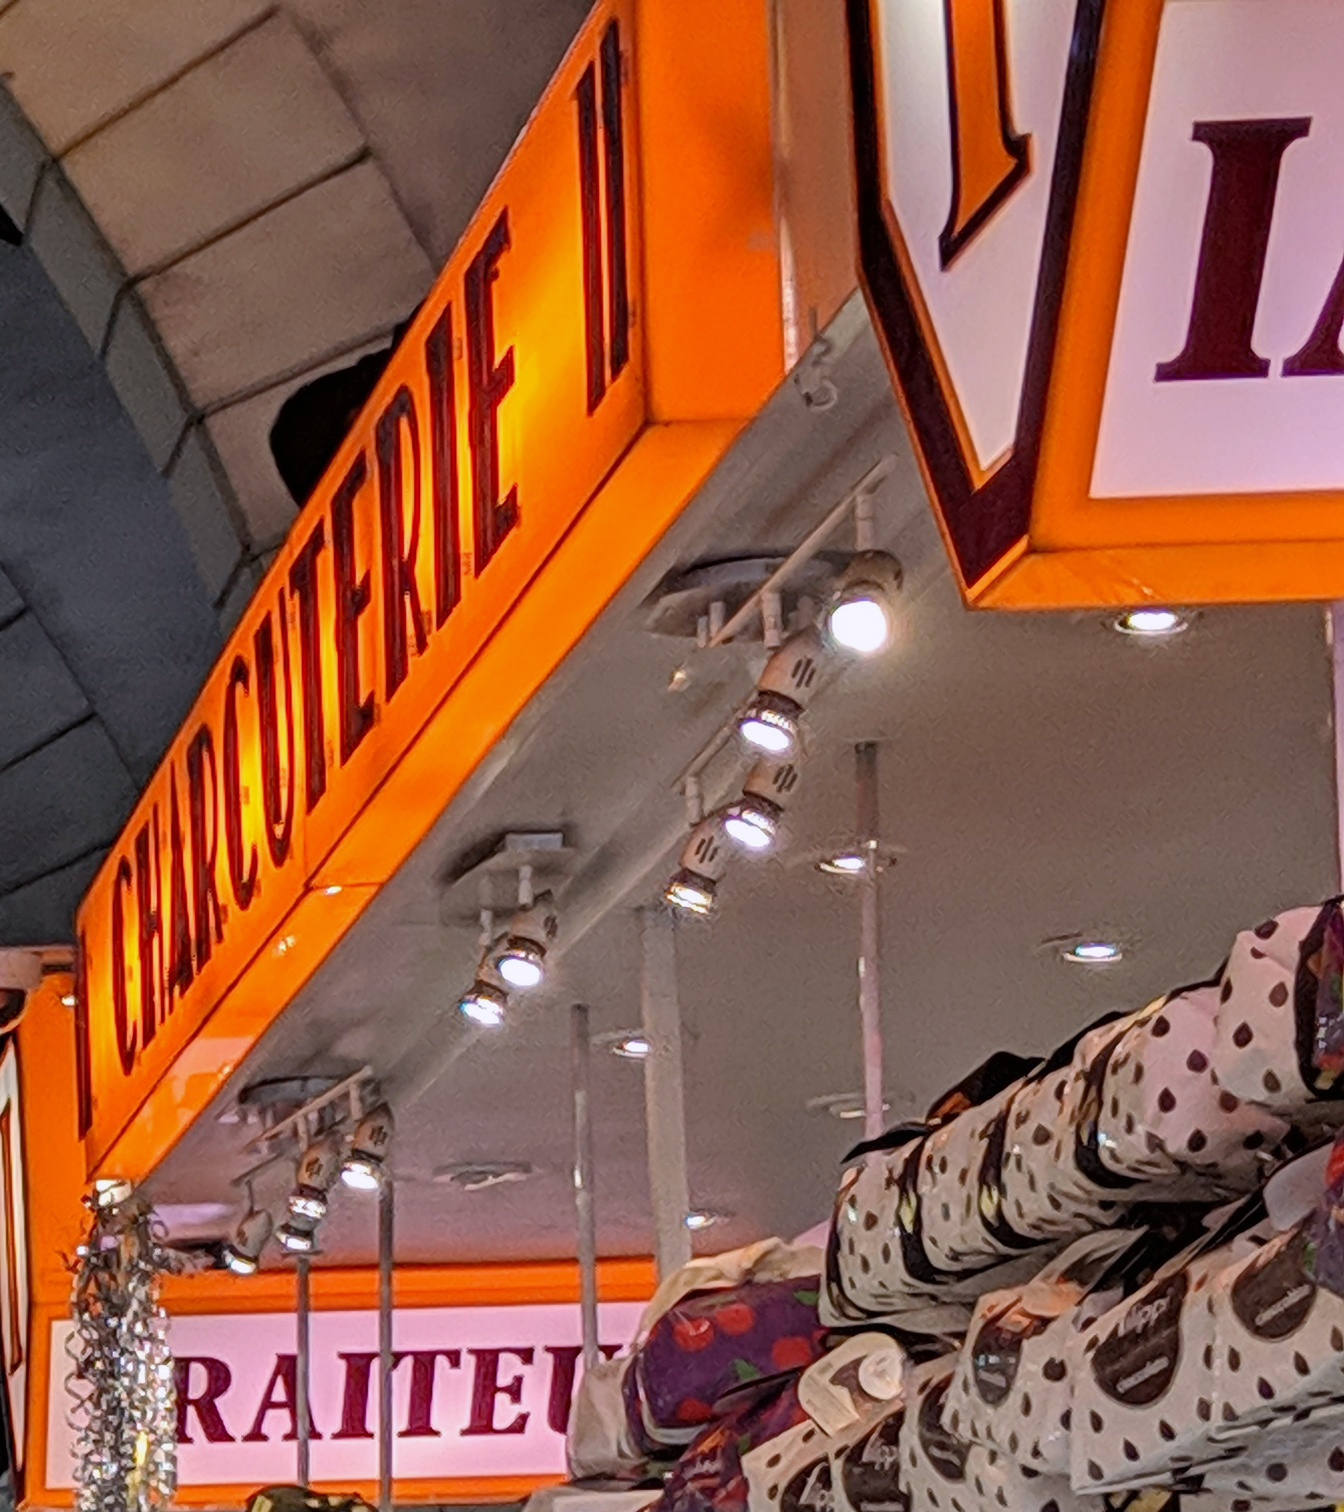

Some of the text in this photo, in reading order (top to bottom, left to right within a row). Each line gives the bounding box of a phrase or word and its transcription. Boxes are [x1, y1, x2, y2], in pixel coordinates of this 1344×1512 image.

[1153, 116, 1344, 383] I
[110, 207, 520, 1077] CHARCUTERIE
[173, 1344, 624, 1445] RAITEU
